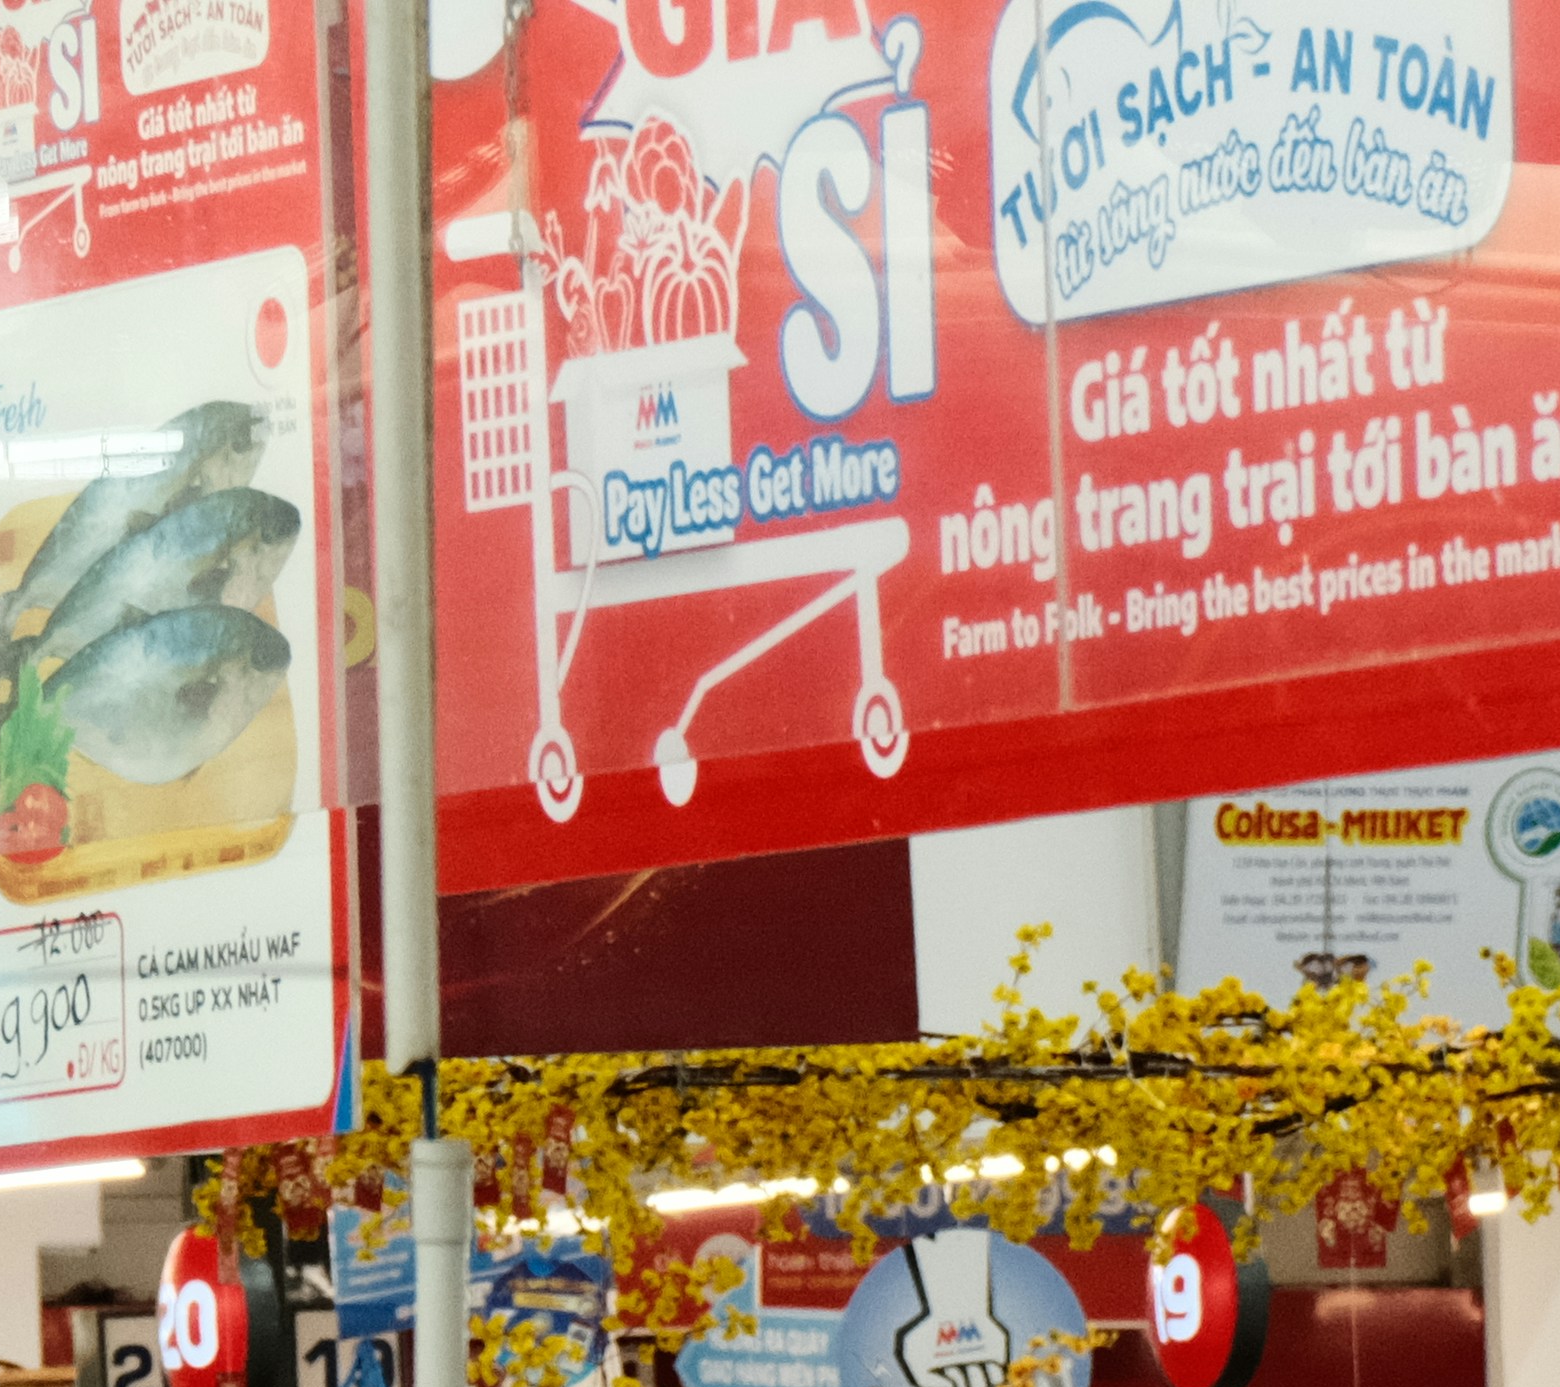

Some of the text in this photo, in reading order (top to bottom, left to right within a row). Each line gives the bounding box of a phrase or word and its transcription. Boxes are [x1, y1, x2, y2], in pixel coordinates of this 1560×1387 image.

[139, 106, 164, 139] Giá
[197, 86, 233, 125] nhất
[1116, 39, 1233, 147] SẠCH
[1291, 28, 1352, 93] AN
[1374, 35, 1495, 140] TOÀN
[98, 156, 137, 189] nông
[141, 147, 185, 178] trang
[248, 120, 279, 156] bàn
[1071, 297, 1448, 442] Giá tốt nhất từ
[603, 435, 897, 558] Pay Less Get More
[940, 484, 1057, 581] nông
[1076, 470, 1211, 557] trang
[1224, 431, 1315, 546] trại
[1328, 417, 1402, 510] tới
[1416, 405, 1516, 498] bàn
[944, 616, 1005, 658] Farm
[1012, 611, 1040, 649] to
[1126, 584, 1197, 635] Bring
[1202, 575, 1248, 622] the
[1254, 562, 1313, 612] best
[1319, 555, 1402, 613] prices
[1408, 545, 1435, 590] in
[1442, 536, 1489, 584] the
[165, 948, 199, 976] CAM
[265, 931, 301, 959] WAF
[186, 988, 204, 1015] UP
[211, 985, 233, 1012] XX
[139, 1033, 207, 1070] (407000)
